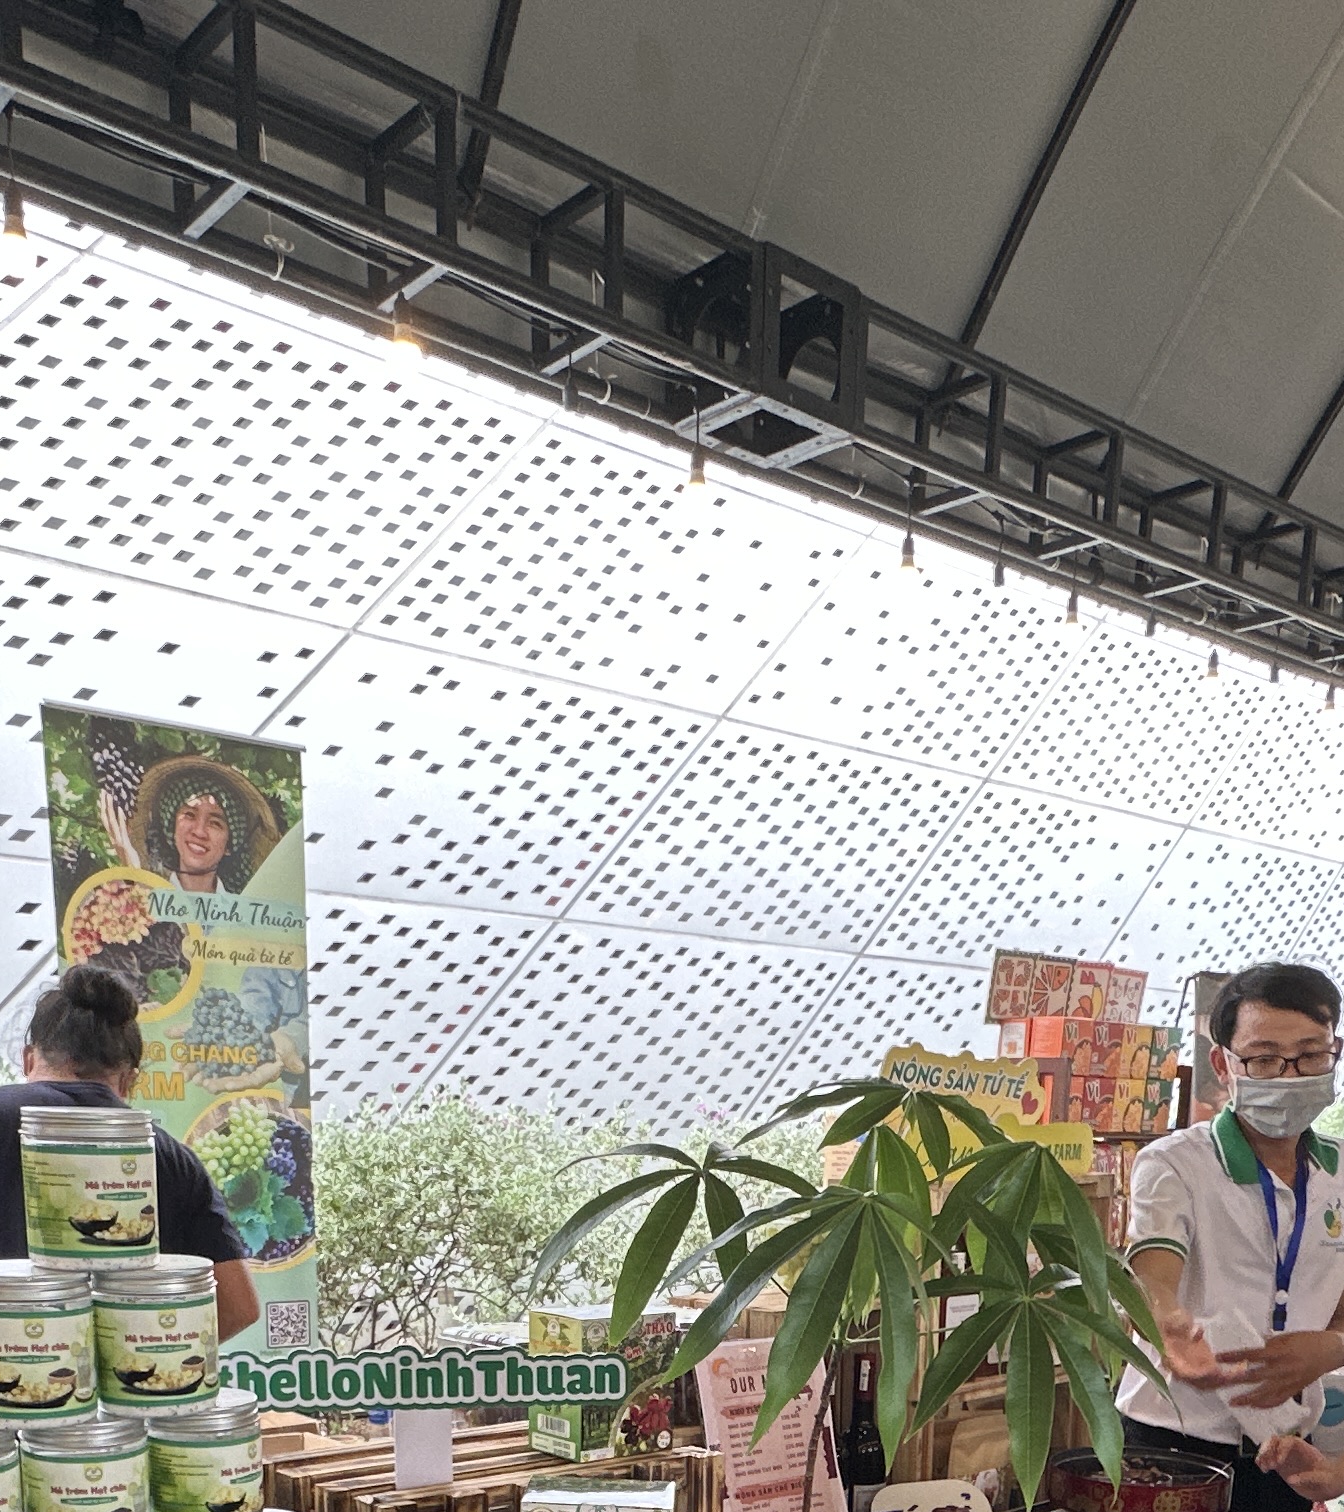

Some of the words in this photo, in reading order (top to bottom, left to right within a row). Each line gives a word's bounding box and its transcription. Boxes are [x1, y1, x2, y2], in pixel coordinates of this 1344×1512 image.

[148, 892, 189, 917] Nho
[195, 897, 243, 922] Ninh
[249, 902, 305, 933] Thuận
[171, 1041, 257, 1064] CHANG
[889, 1056, 942, 1087] NÔNG
[944, 1065, 980, 1092] SẢN
[982, 1069, 1003, 1095] TỬ
[730, 1373, 756, 1394] OUR
